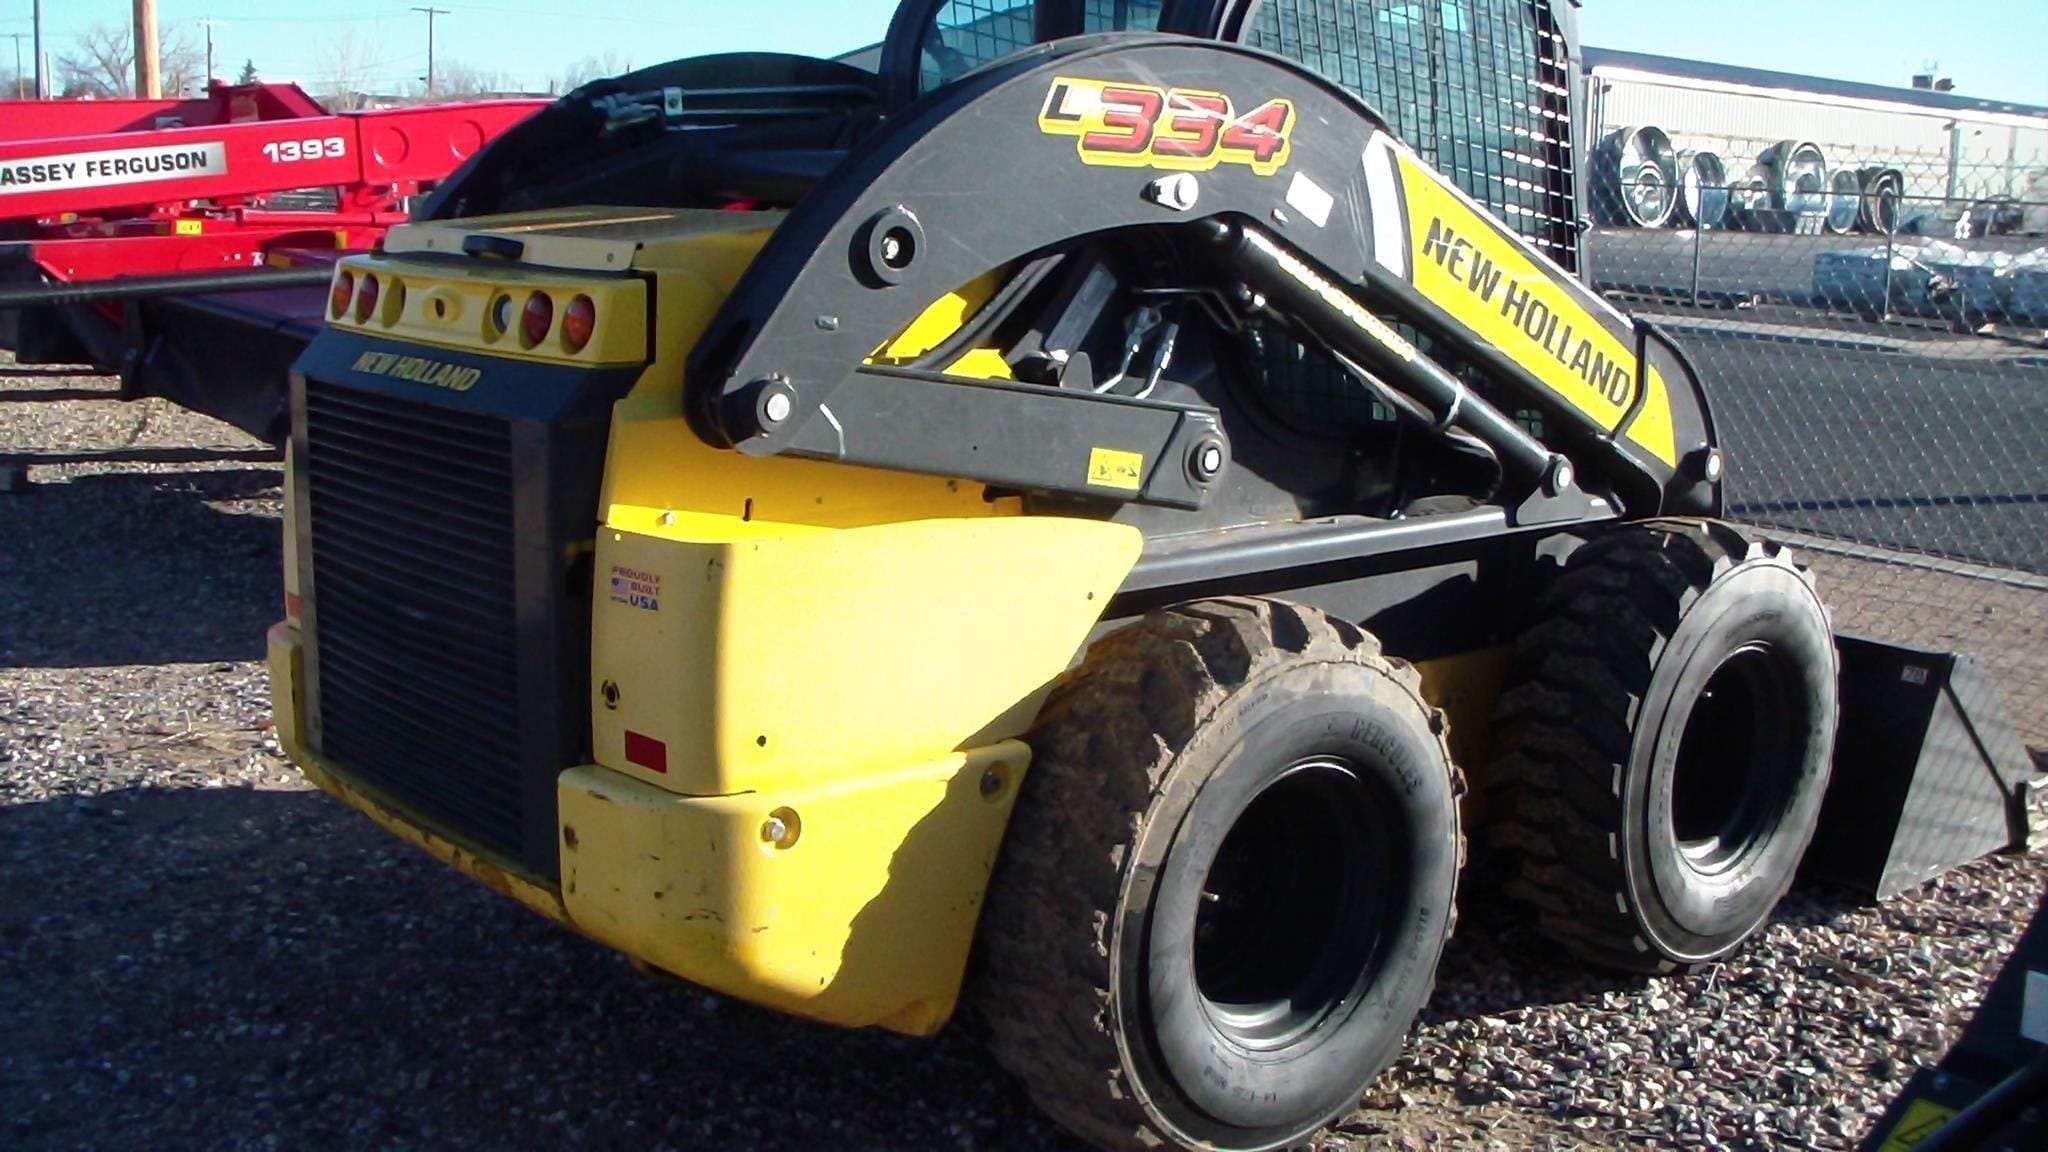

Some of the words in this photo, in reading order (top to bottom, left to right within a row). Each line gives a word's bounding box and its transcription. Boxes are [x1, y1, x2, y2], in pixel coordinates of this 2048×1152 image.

[86, 149, 208, 178] FERGUSON
[263, 137, 345, 163] 1393
[1422, 216, 1502, 302] NEW
[1500, 279, 1632, 408] HOLLAND
[351, 351, 400, 375] NEW
[388, 355, 482, 391] HOLLAND
[630, 594, 658, 611] USA
